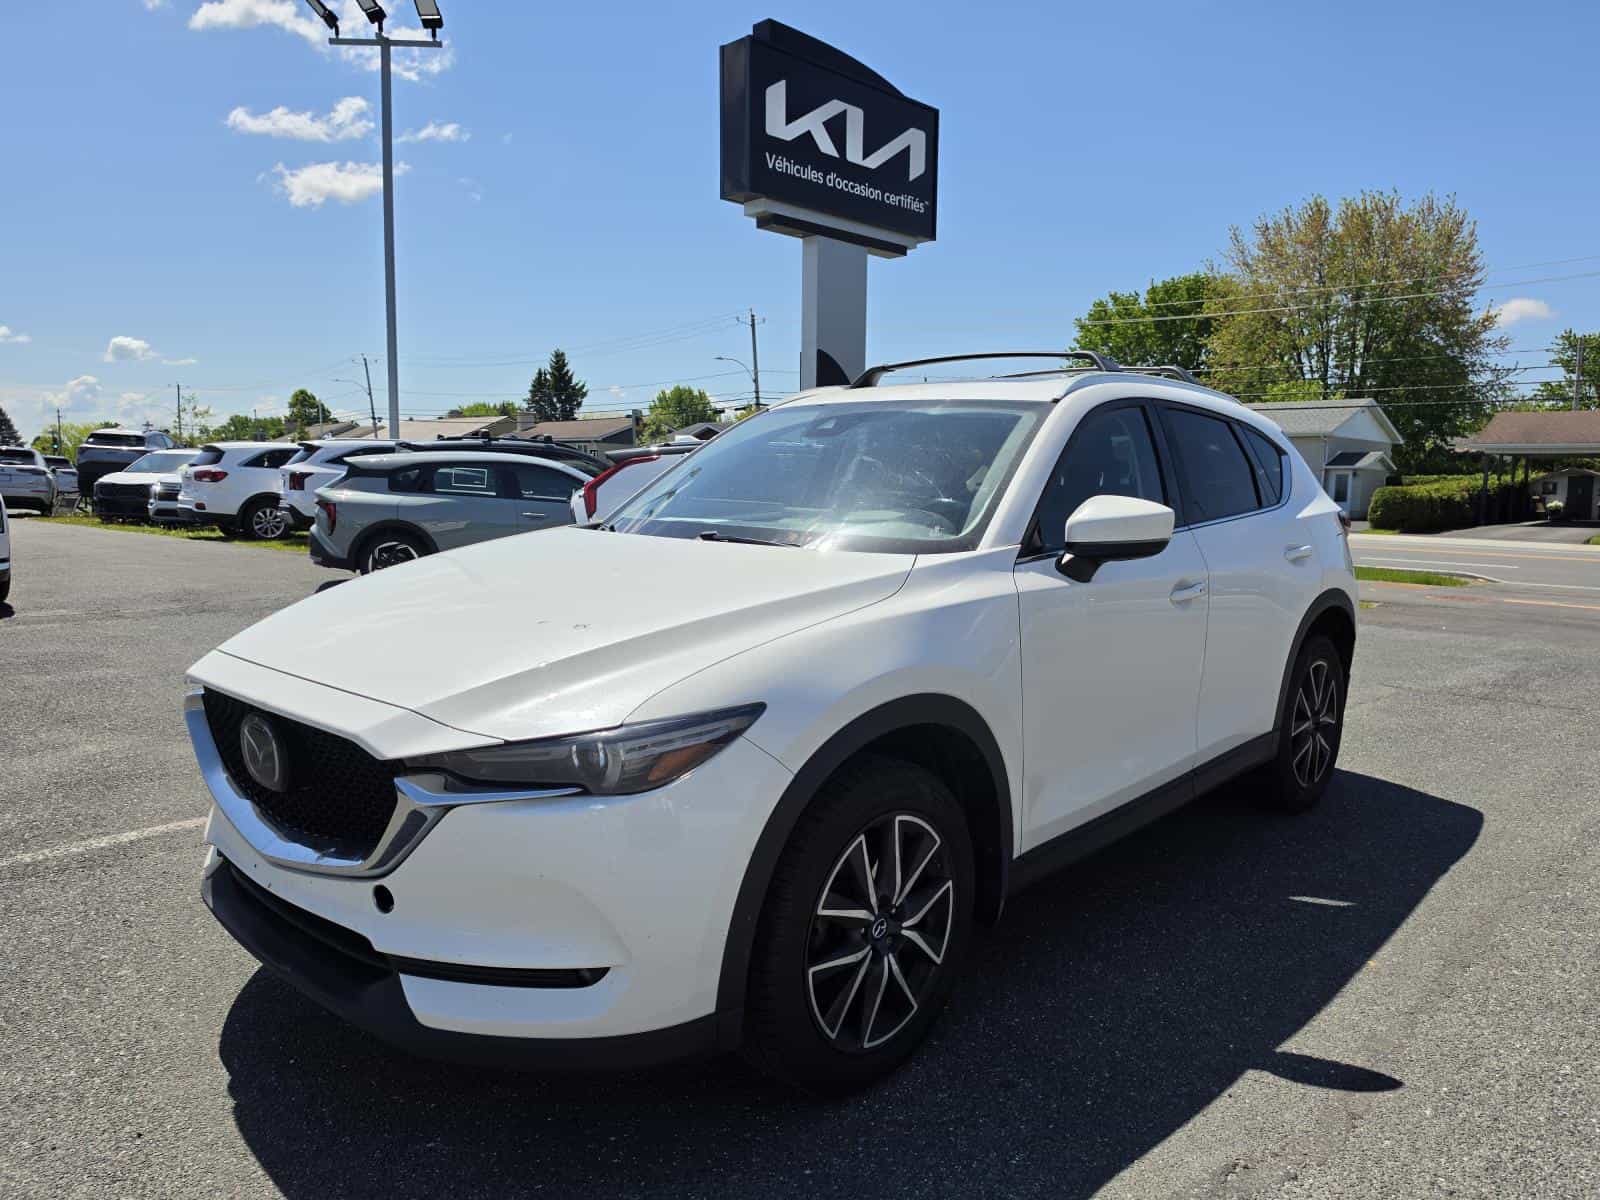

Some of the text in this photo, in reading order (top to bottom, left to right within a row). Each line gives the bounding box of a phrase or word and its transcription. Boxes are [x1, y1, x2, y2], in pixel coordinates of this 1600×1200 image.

[765, 80, 927, 182] KIA
[765, 152, 925, 213] Véhicules d'occasion certifiés
